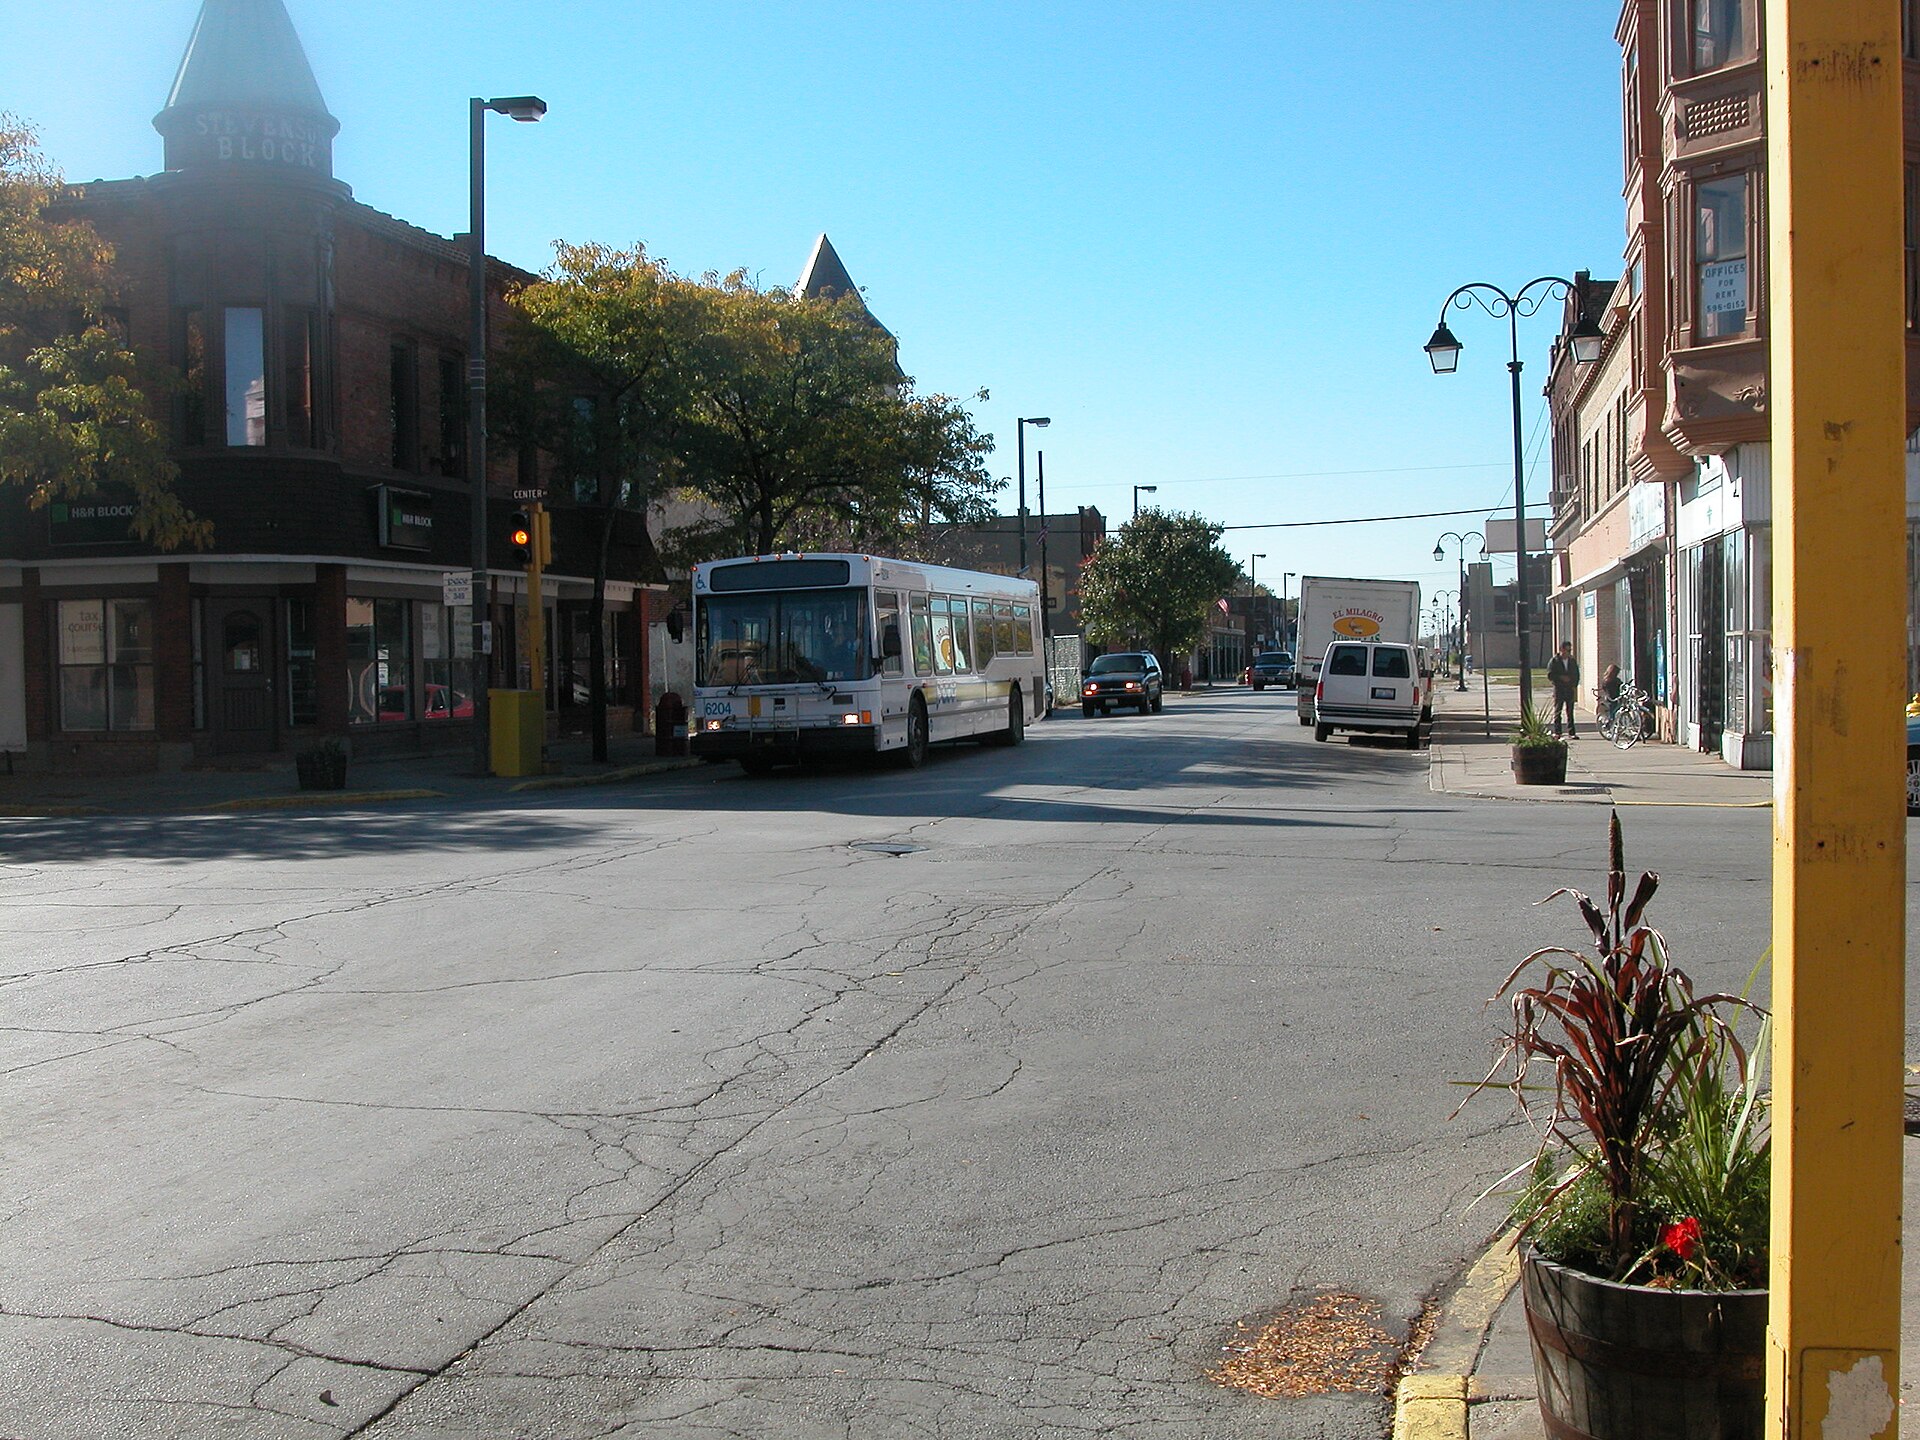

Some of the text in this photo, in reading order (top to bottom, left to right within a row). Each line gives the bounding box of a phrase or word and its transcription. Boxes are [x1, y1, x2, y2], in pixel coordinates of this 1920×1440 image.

[217, 136, 316, 168] BLOCK
[1705, 264, 1745, 278] OFFICES
[1715, 290, 1736, 299] RENT
[513, 489, 542, 499] CENTER
[71, 504, 134, 519] H&R BLOCK
[79, 611, 98, 621] tax
[1332, 608, 1384, 623] EL MILAGRO
[705, 702, 732, 716] 6204
